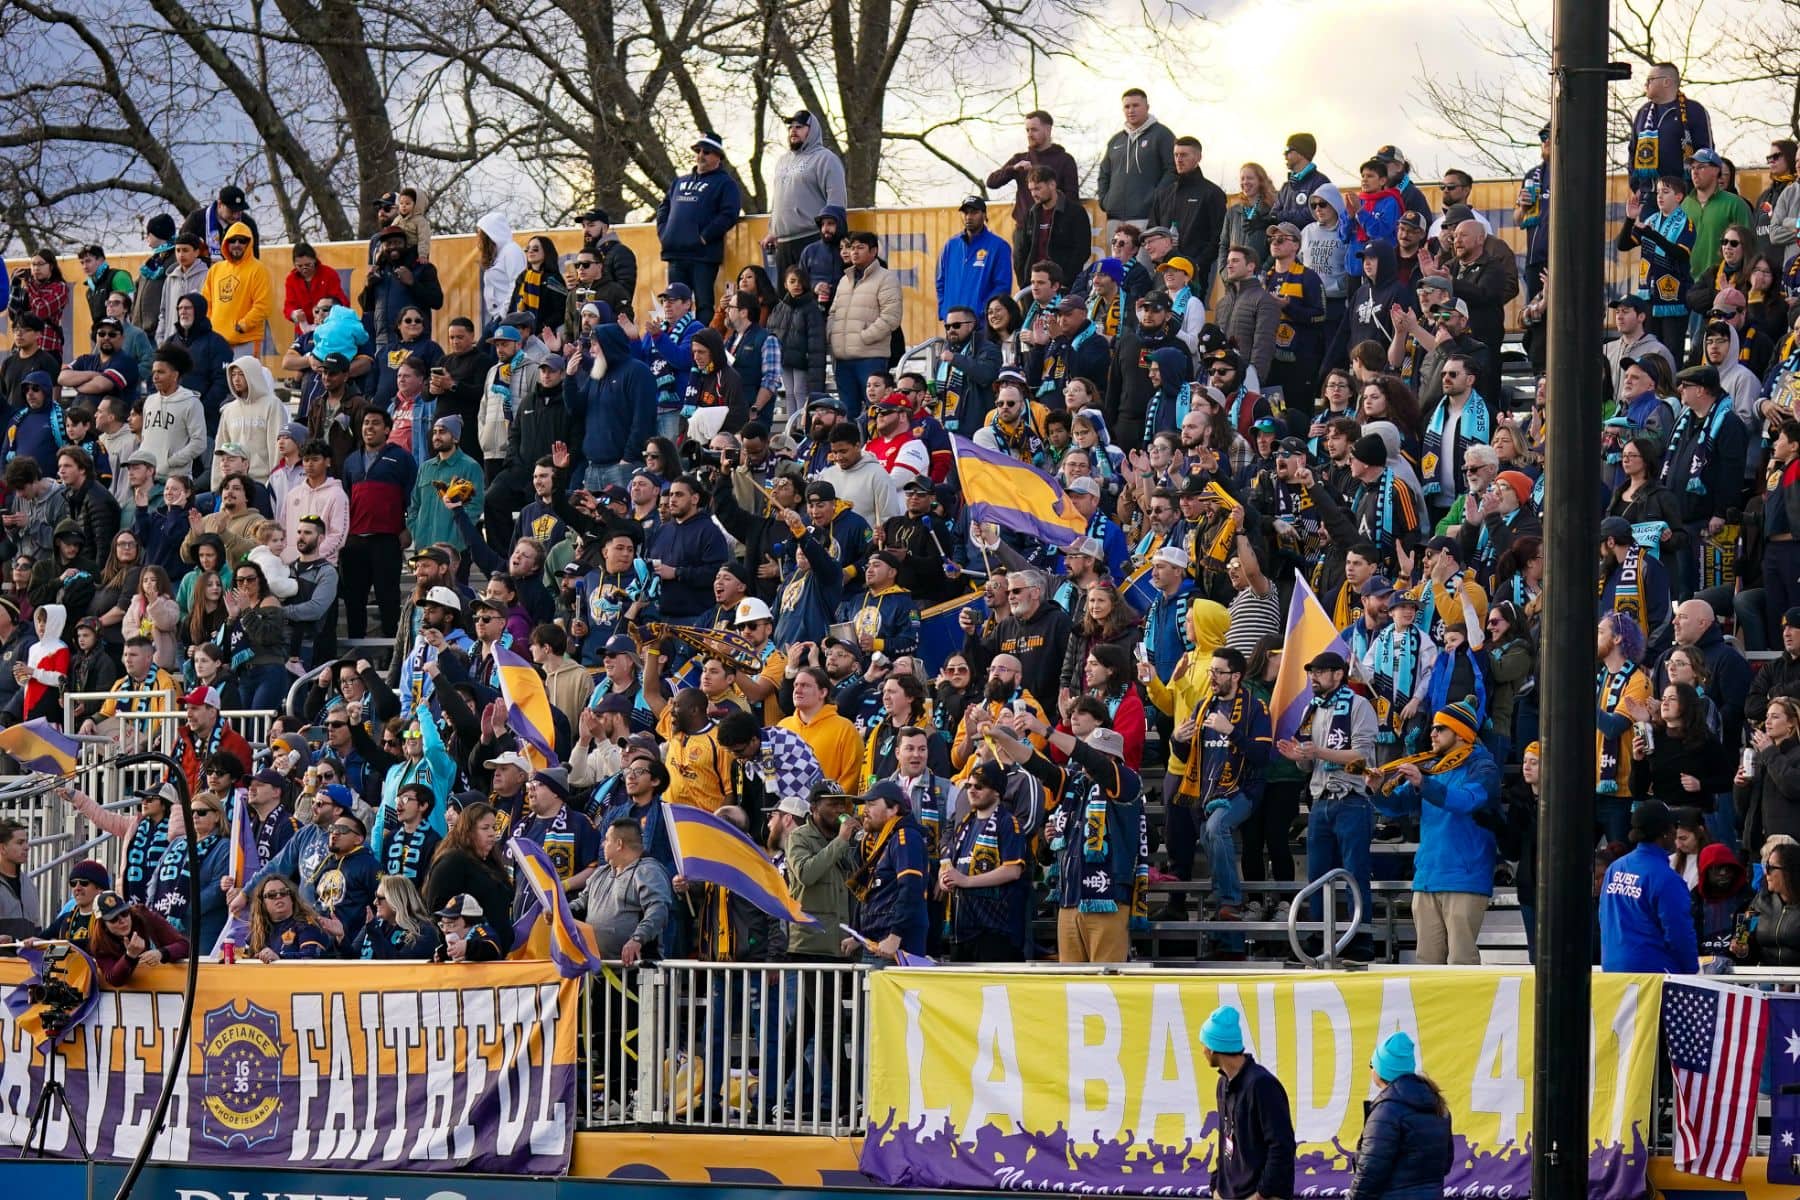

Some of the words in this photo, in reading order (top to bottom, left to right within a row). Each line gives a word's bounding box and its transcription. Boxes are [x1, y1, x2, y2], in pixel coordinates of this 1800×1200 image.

[679, 181, 709, 193] NIKE
[1310, 248, 1333, 257] DOING
[1321, 240, 1339, 249] ALEX
[1311, 256, 1329, 265] ALEX
[144, 410, 175, 430] GAP
[1612, 871, 1640, 884] GUEST
[1606, 884, 1643, 899] SERVICES
[215, 1027, 270, 1051] DEFIANCE
[235, 1061, 250, 1077] 16
[903, 984, 1024, 1143] LA
[1065, 977, 1424, 1144] BANDA
[1471, 976, 1640, 1149] 41
[288, 984, 567, 1161] FAITHFUL
[233, 1077, 249, 1093] 36
[214, 1104, 239, 1125] RHODE
[241, 1104, 270, 1125] ISLAND
